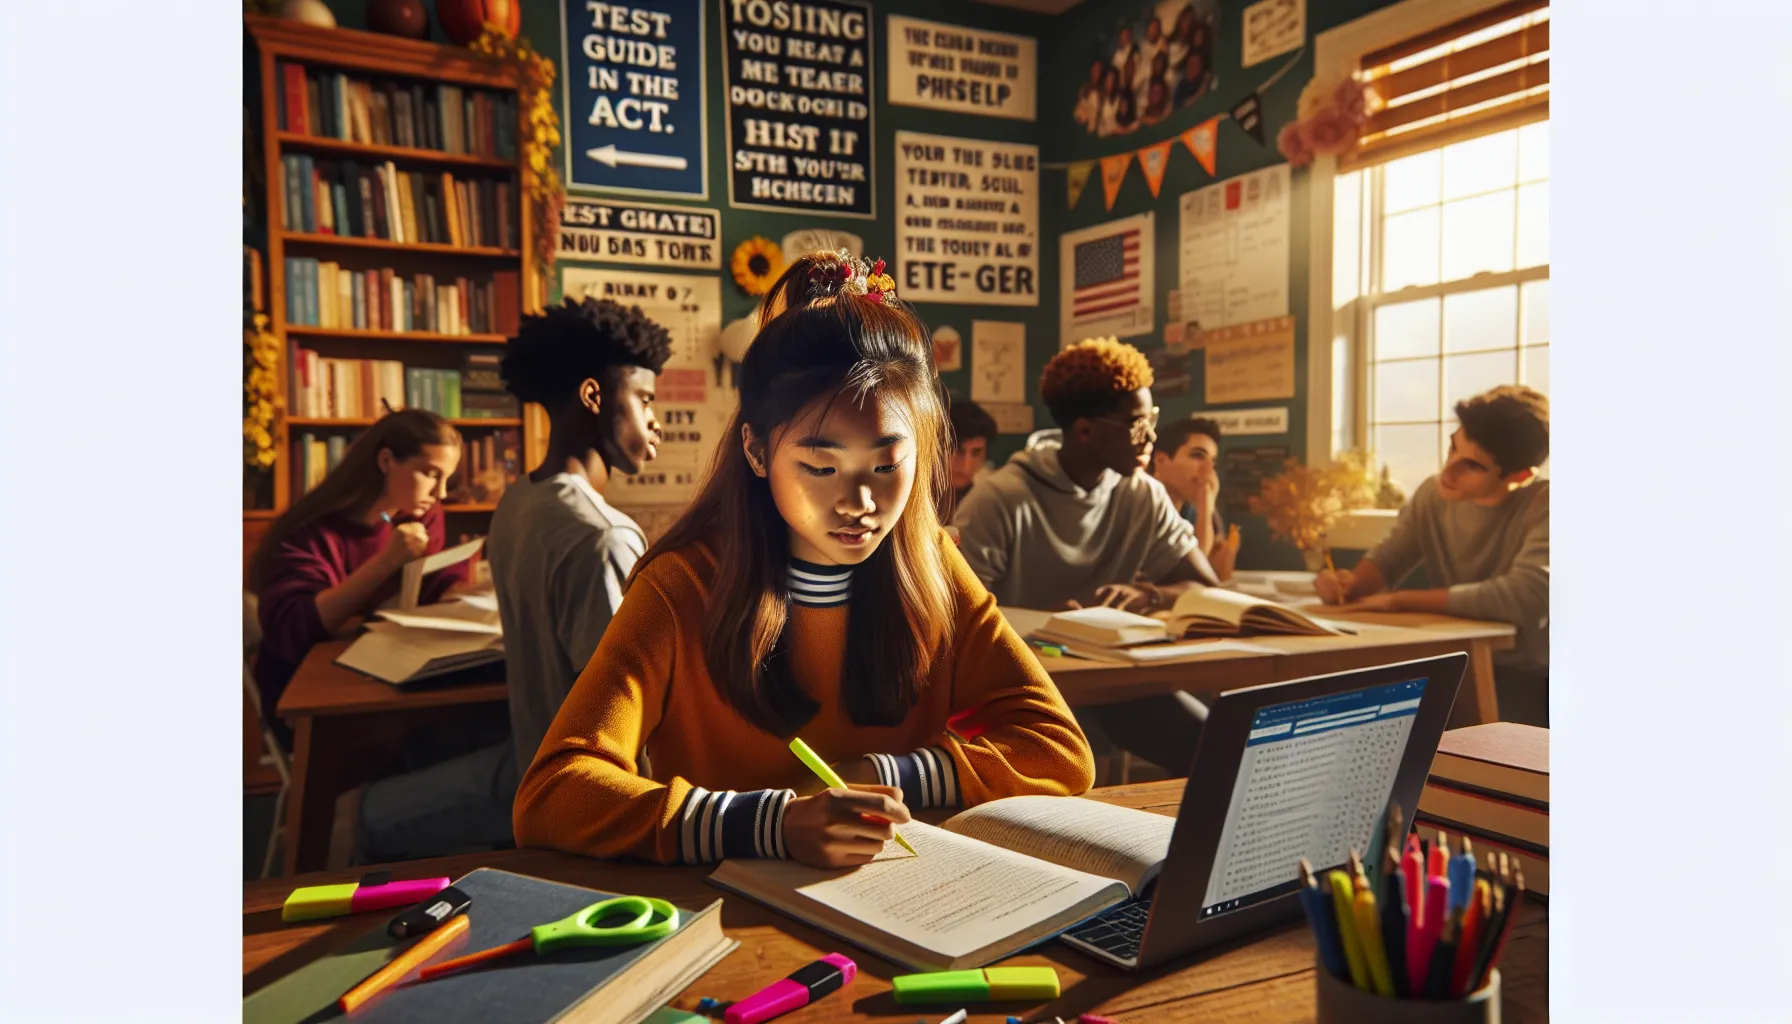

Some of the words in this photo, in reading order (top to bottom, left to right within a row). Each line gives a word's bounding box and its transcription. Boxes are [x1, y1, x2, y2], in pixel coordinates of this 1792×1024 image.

[586, 1, 672, 38] TEST
[582, 33, 677, 70] GUIDE
[733, 29, 780, 56] YOU
[588, 66, 619, 91] IN
[626, 72, 679, 100] THE
[588, 95, 676, 134] ACT.
